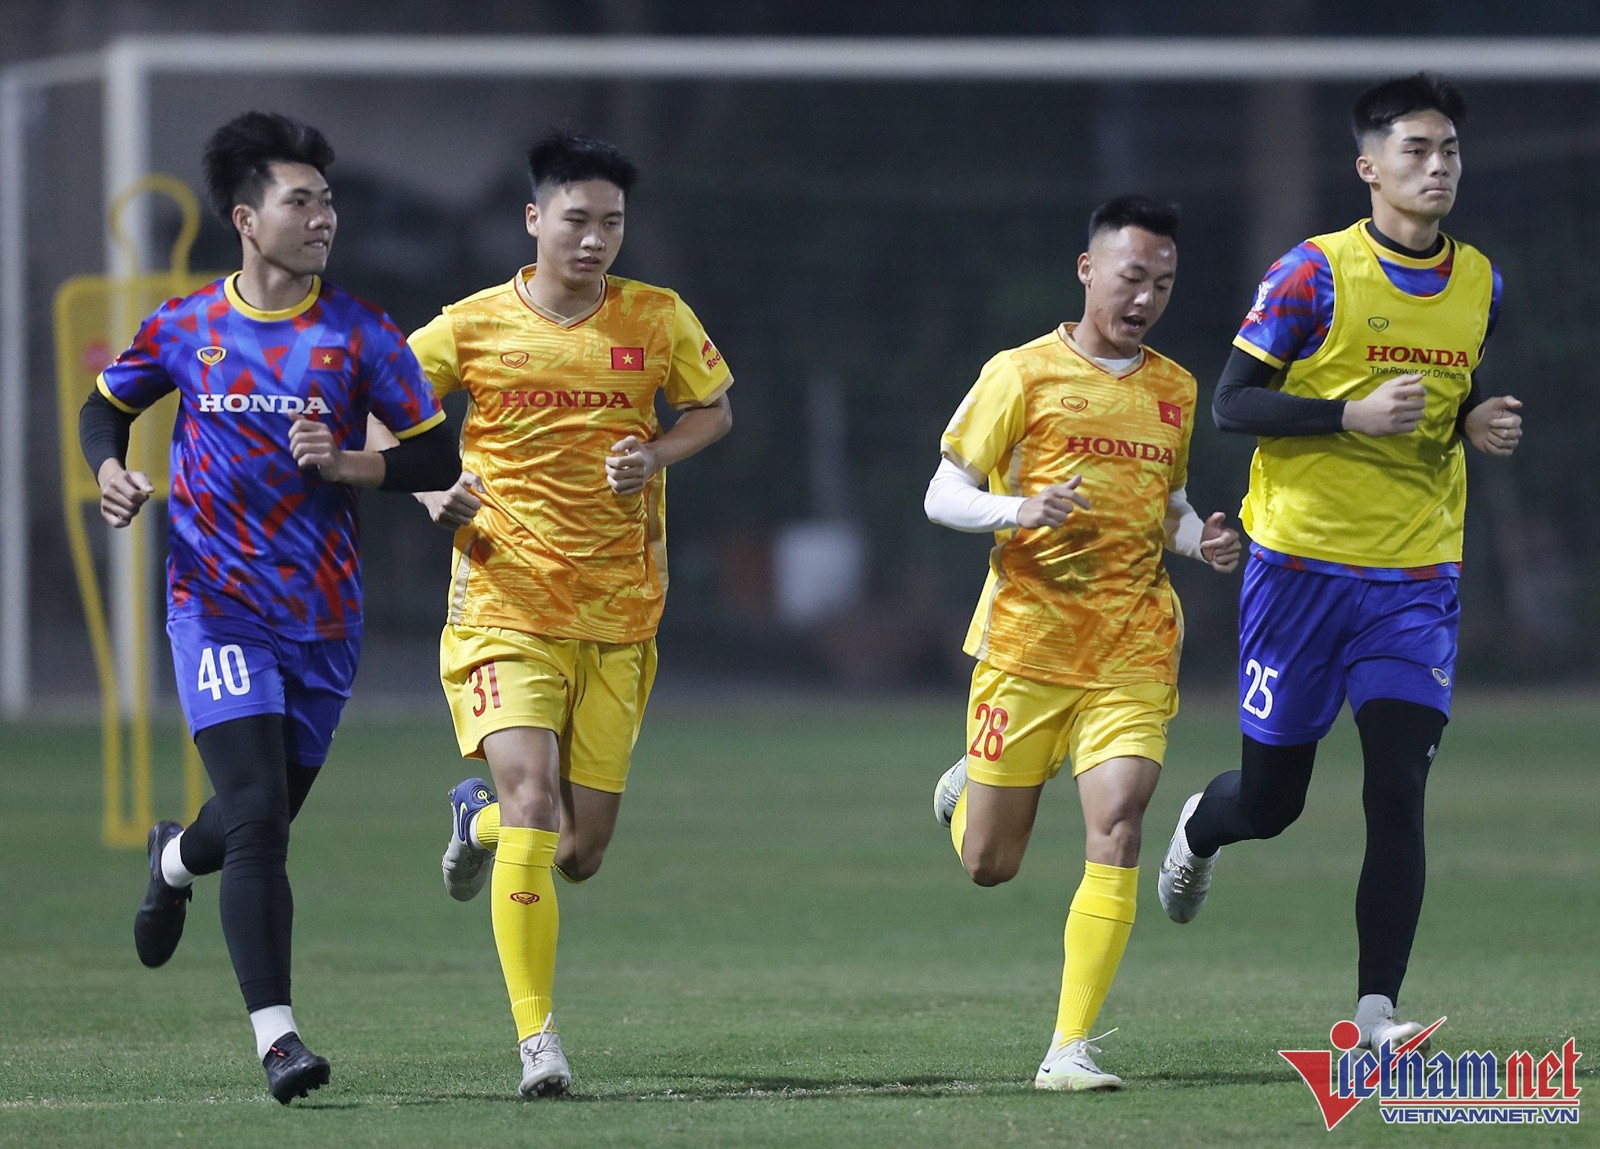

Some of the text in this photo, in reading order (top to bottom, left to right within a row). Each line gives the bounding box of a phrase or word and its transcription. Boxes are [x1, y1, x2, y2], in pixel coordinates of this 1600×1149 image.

[1366, 345, 1469, 367] HONDA
[1370, 366, 1389, 374] The
[1390, 366, 1418, 375] Power
[1433, 370, 1466, 380] Dreams
[197, 393, 332, 415] HONDA
[500, 390, 633, 409] HONDA
[1065, 436, 1173, 465] HONDA
[198, 644, 251, 701] 40
[468, 659, 501, 717] 31
[1242, 658, 1279, 720] 25
[969, 703, 1009, 762] 28
